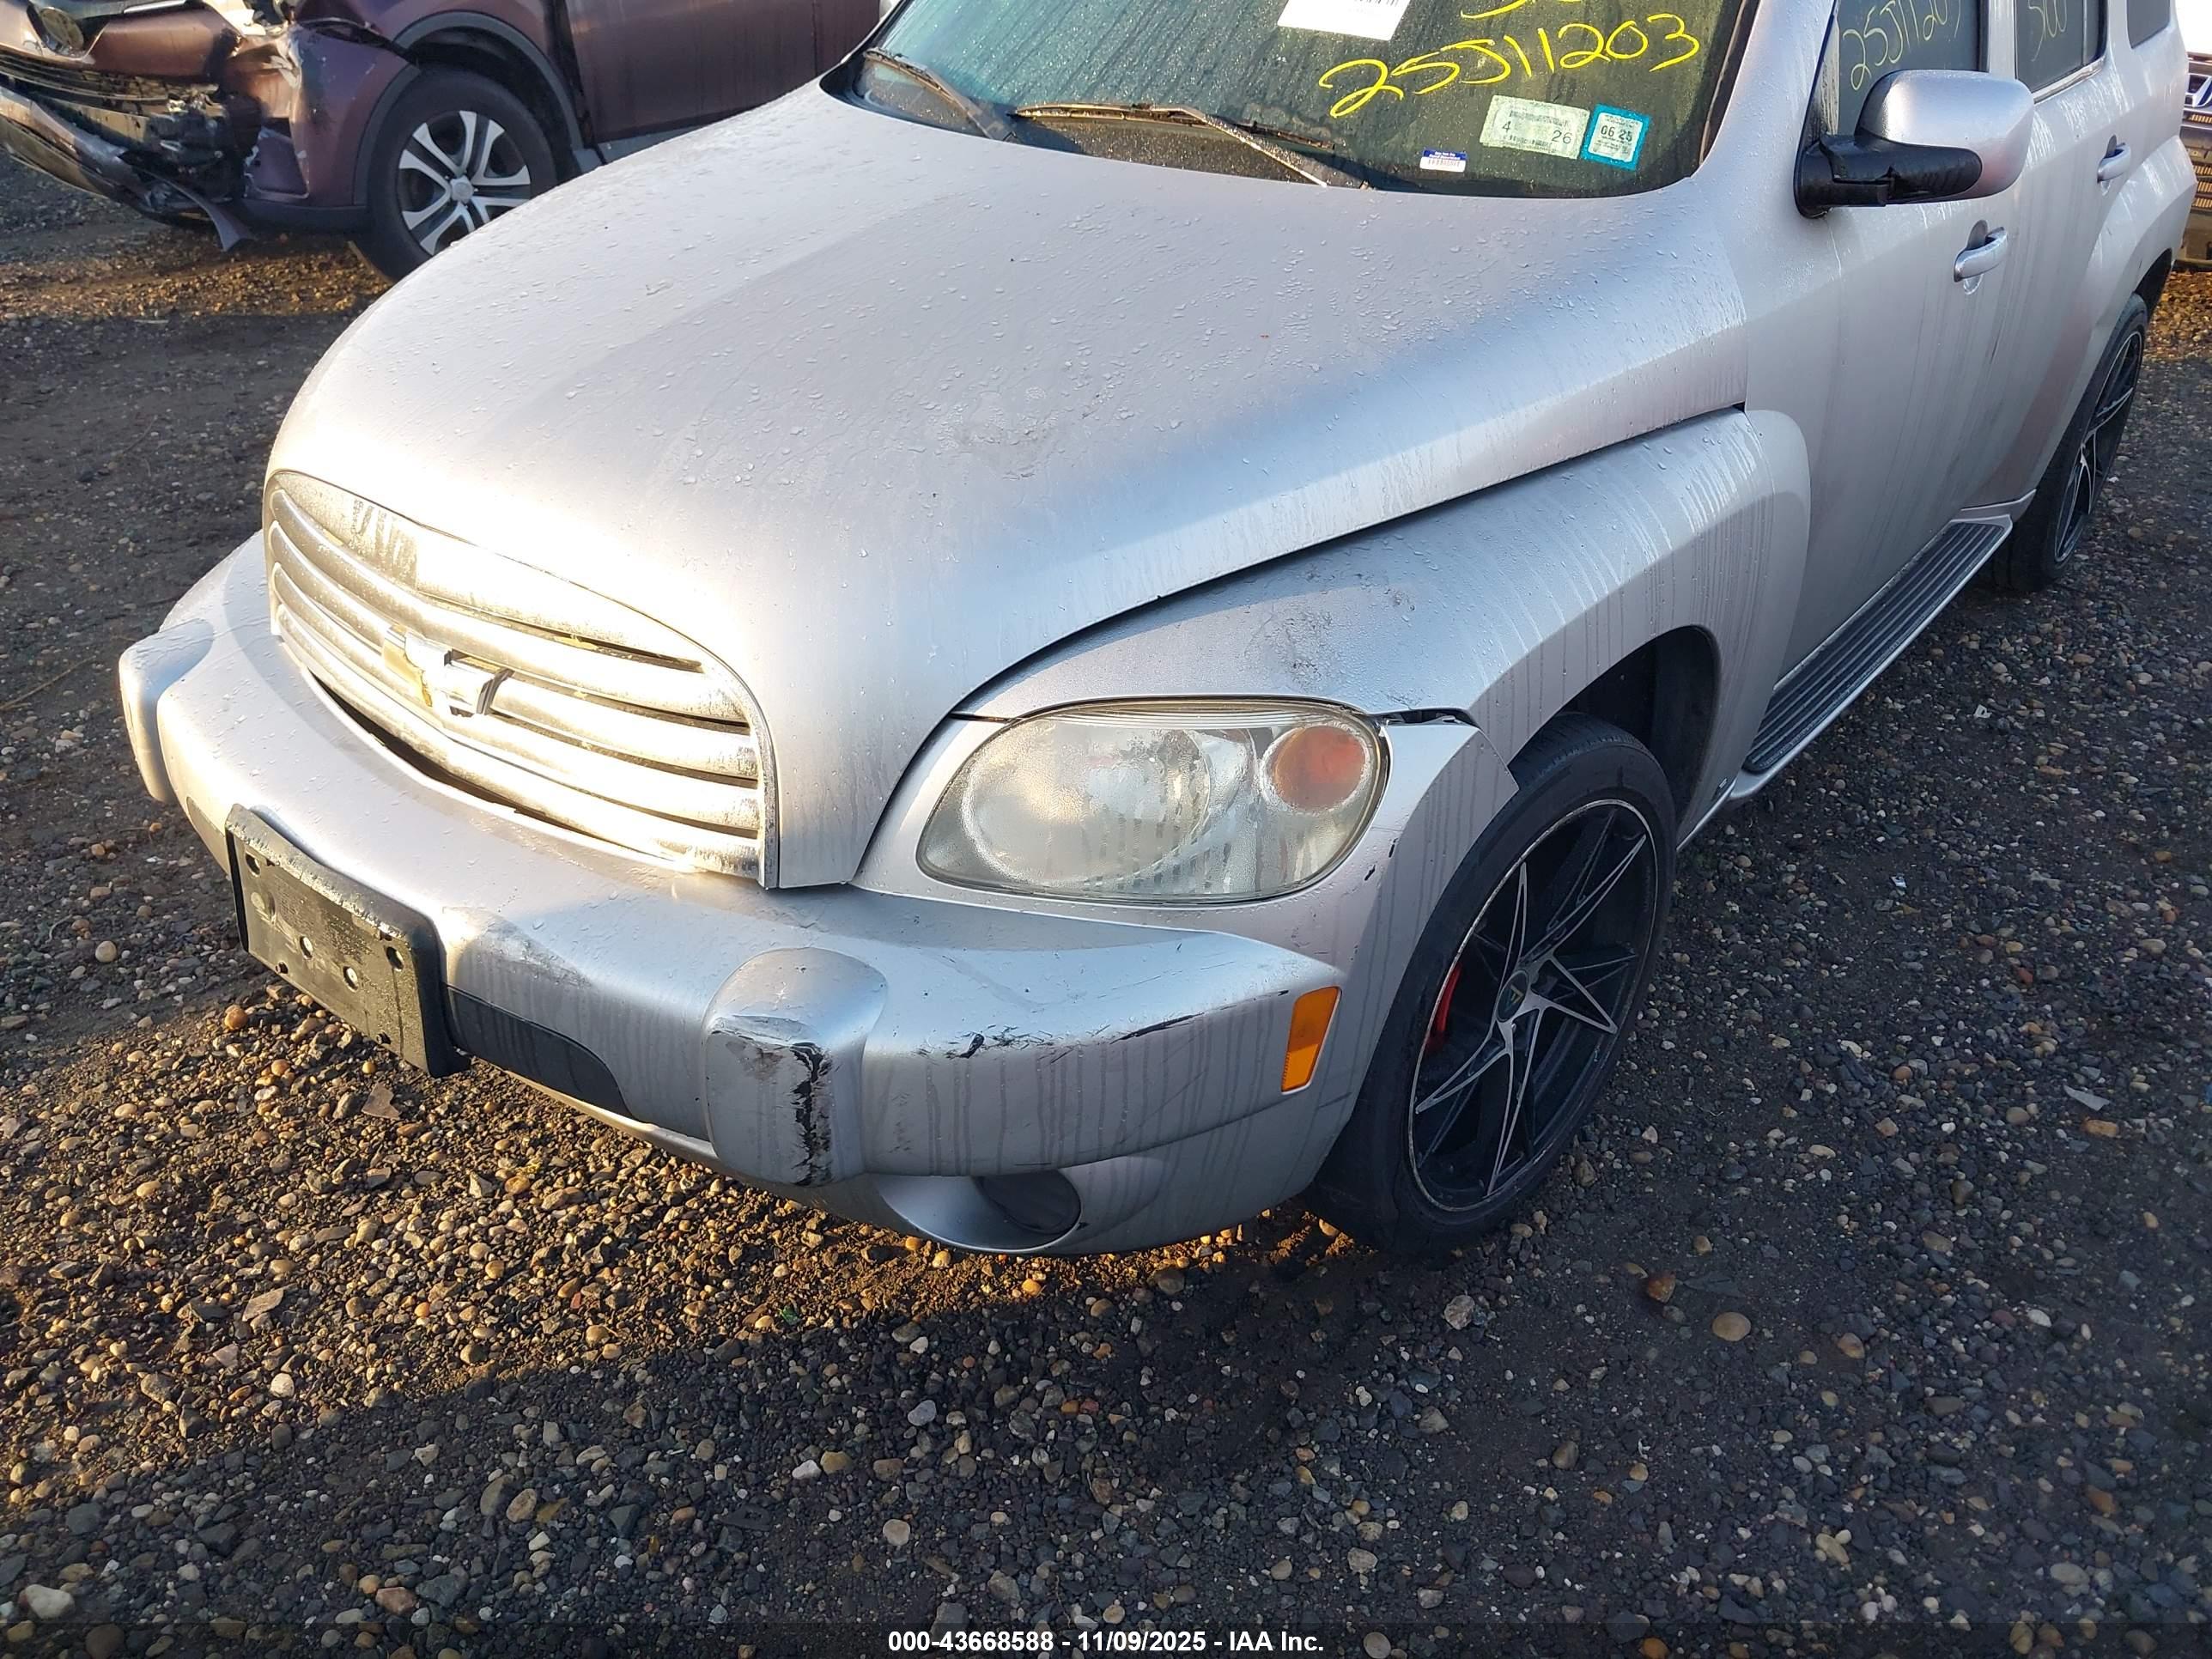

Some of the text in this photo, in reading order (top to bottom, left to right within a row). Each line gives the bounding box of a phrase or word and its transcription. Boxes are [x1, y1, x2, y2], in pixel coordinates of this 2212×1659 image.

[1502, 120, 1511, 133] 4
[1551, 130, 1573, 145] 26
[1601, 125, 1633, 143] 06 25
